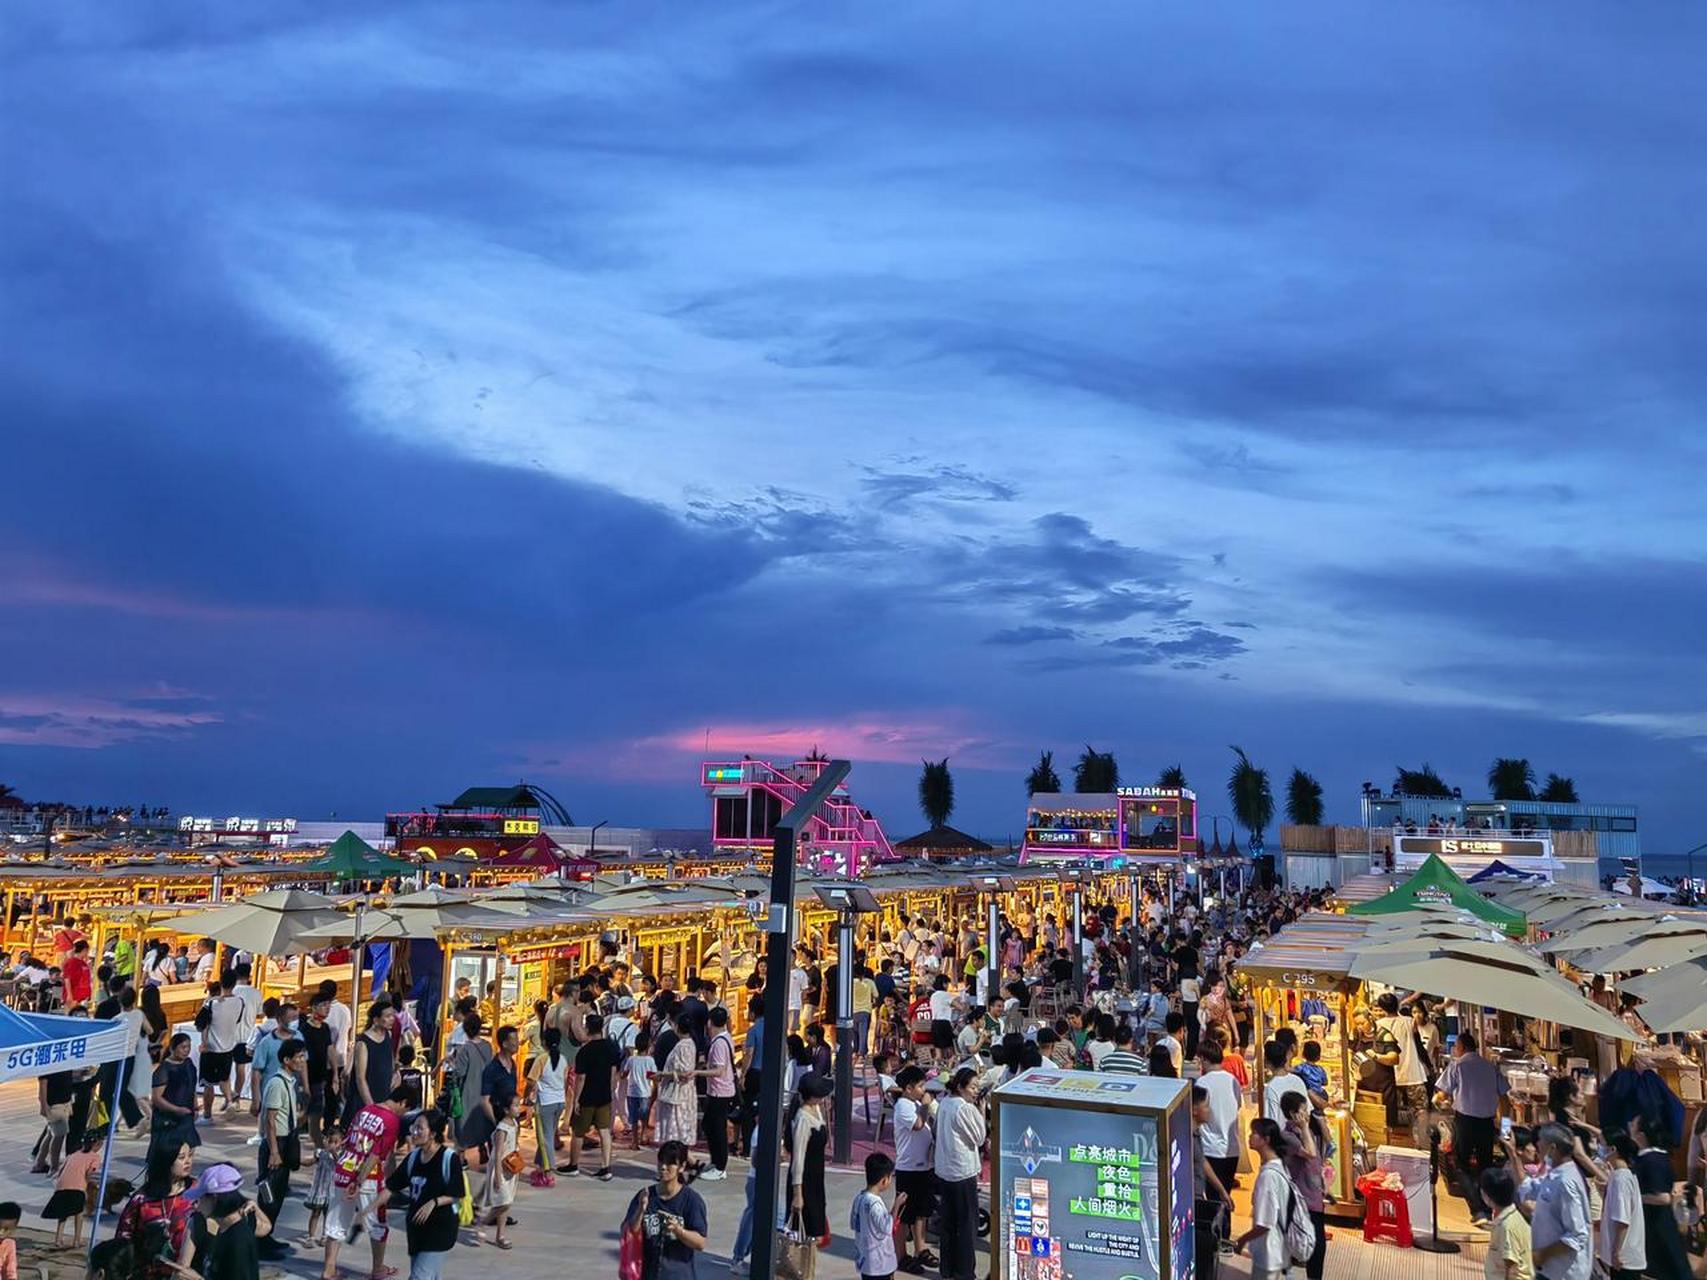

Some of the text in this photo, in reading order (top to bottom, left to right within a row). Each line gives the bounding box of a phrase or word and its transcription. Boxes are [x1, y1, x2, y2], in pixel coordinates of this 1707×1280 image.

[1282, 972, 1291, 984] C
[1074, 1143, 1132, 1163] 点亮城市
[1103, 1182, 1132, 1199] 重拾
